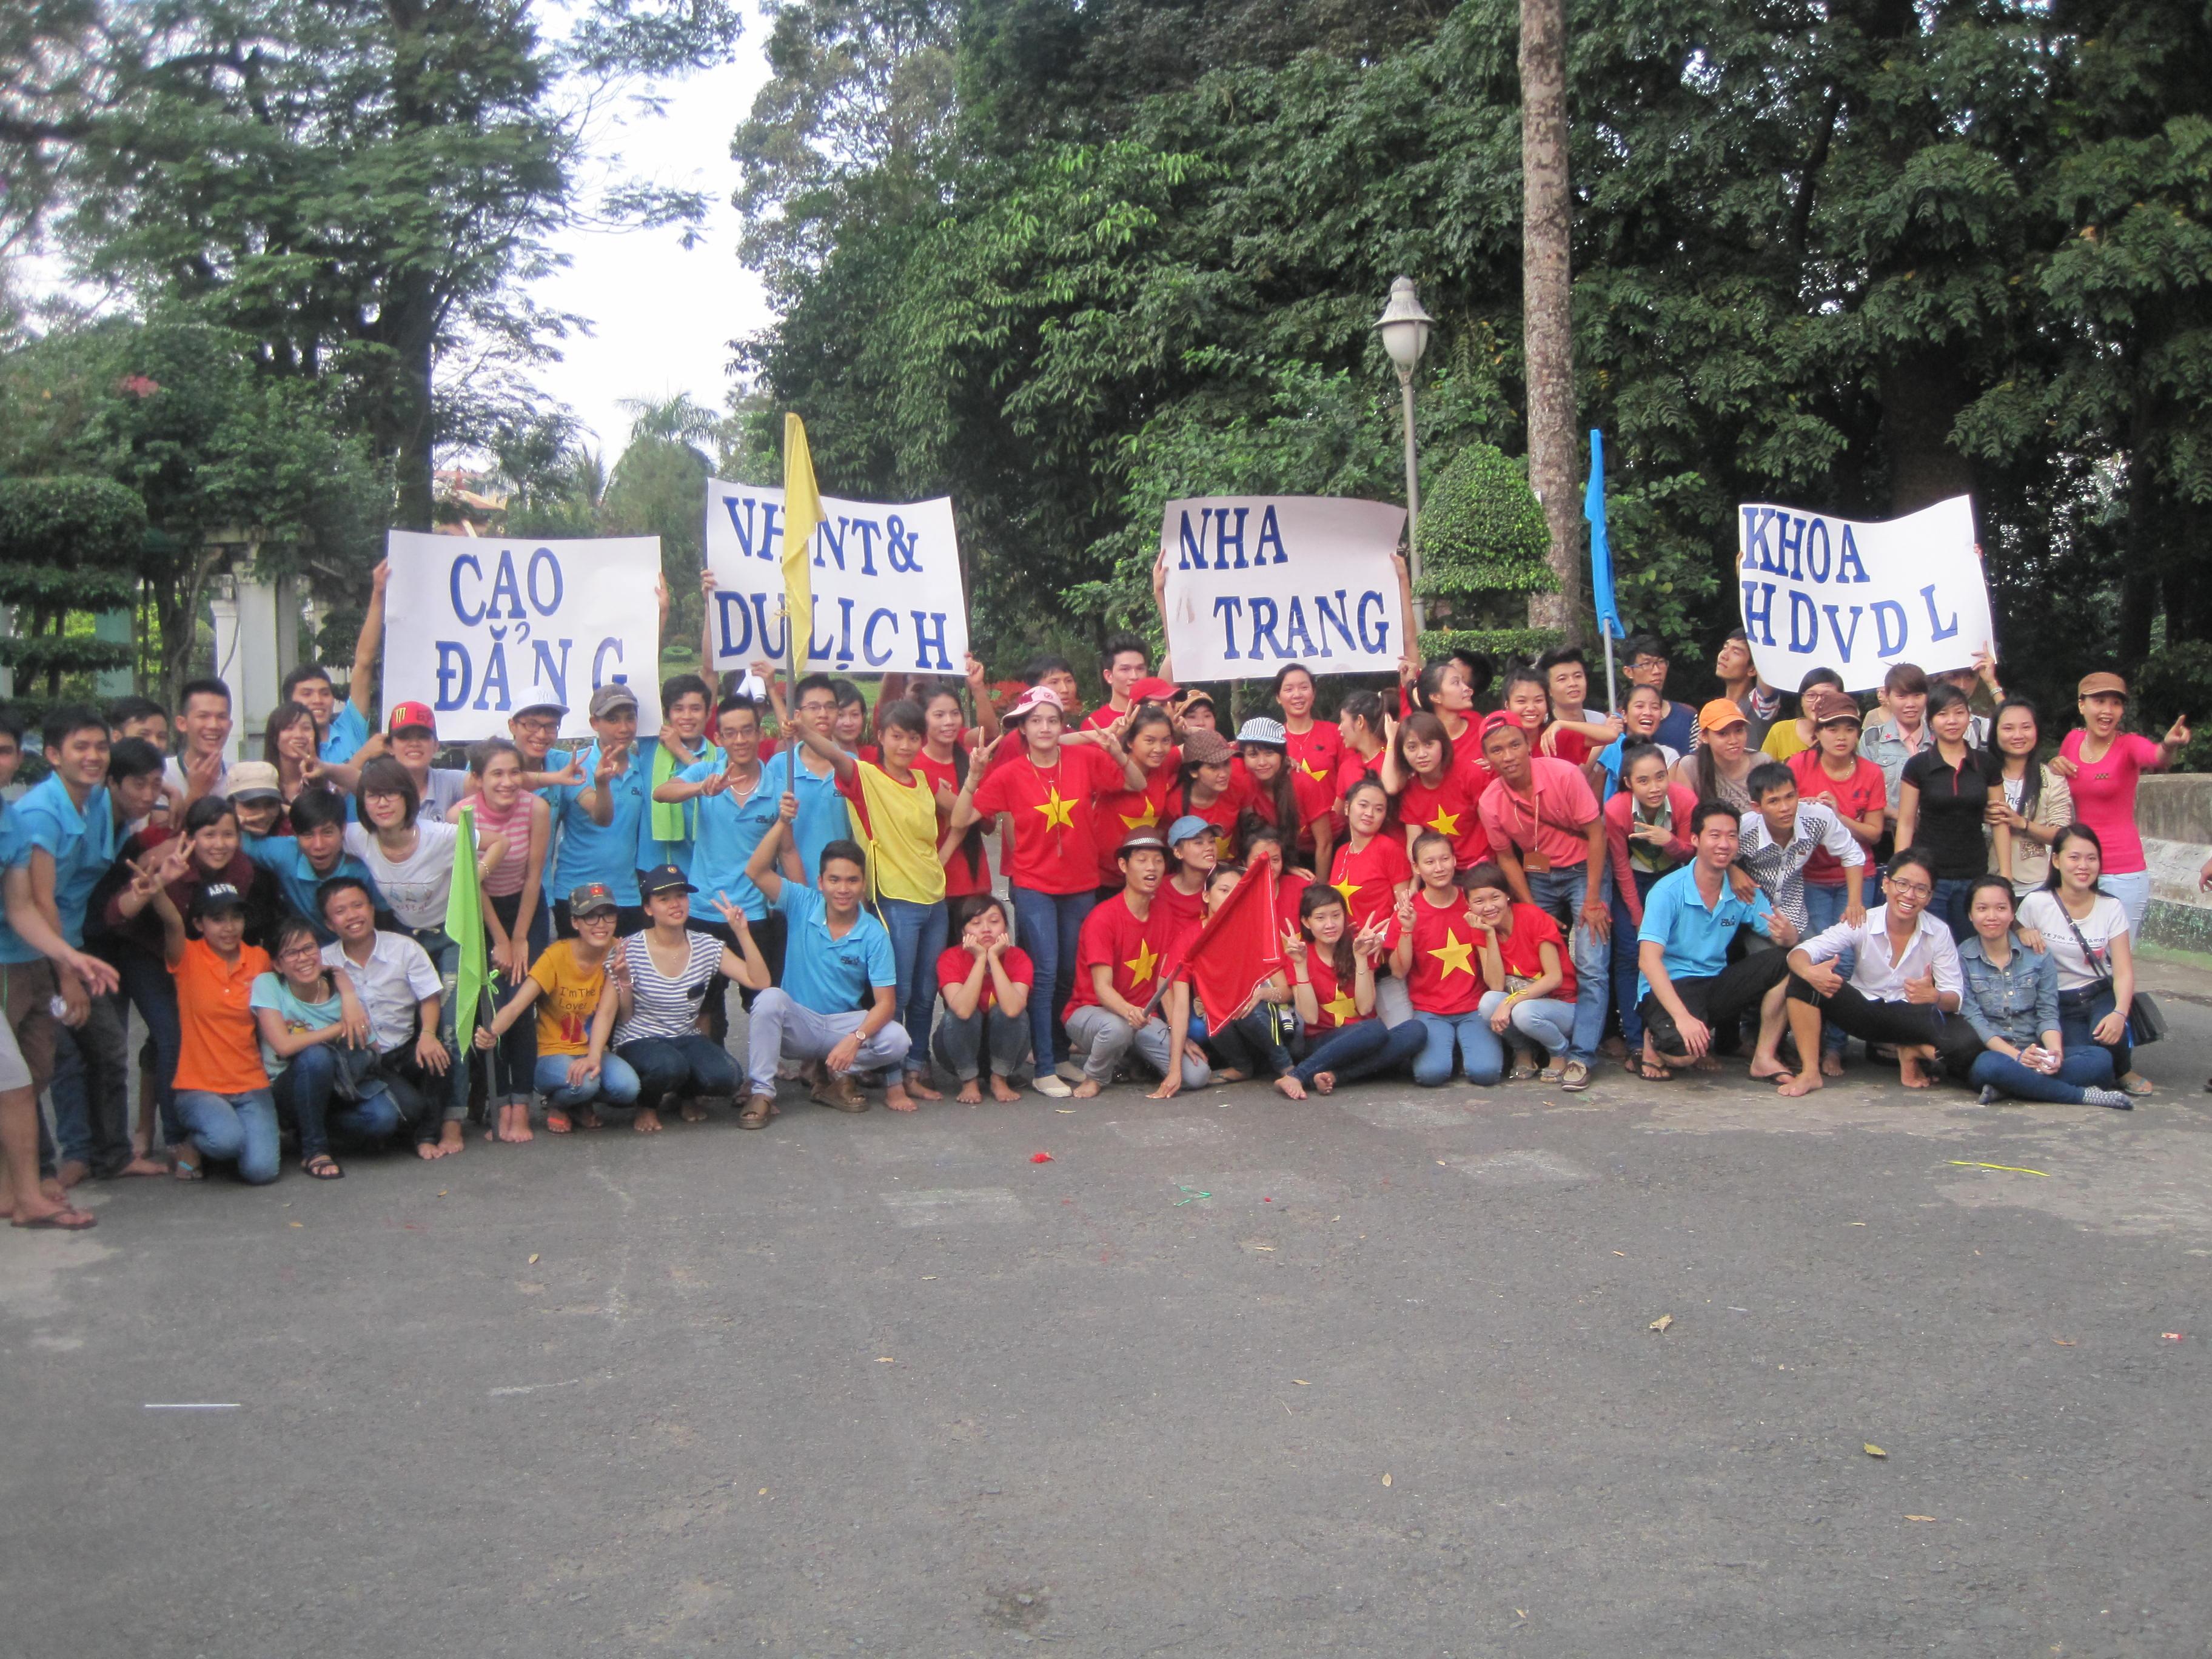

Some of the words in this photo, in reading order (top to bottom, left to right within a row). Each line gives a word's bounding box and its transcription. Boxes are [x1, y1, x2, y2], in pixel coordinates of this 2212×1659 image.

[1178, 504, 1289, 571] NHA
[1741, 507, 1871, 584] KHOA
[450, 547, 563, 627] CAO
[1741, 580, 1959, 663] HDVDL
[714, 590, 787, 660] DU
[1213, 589, 1389, 660] TRANG
[559, 998, 588, 1010] Lover
[560, 987, 577, 997] I'm
[578, 988, 595, 997] The
